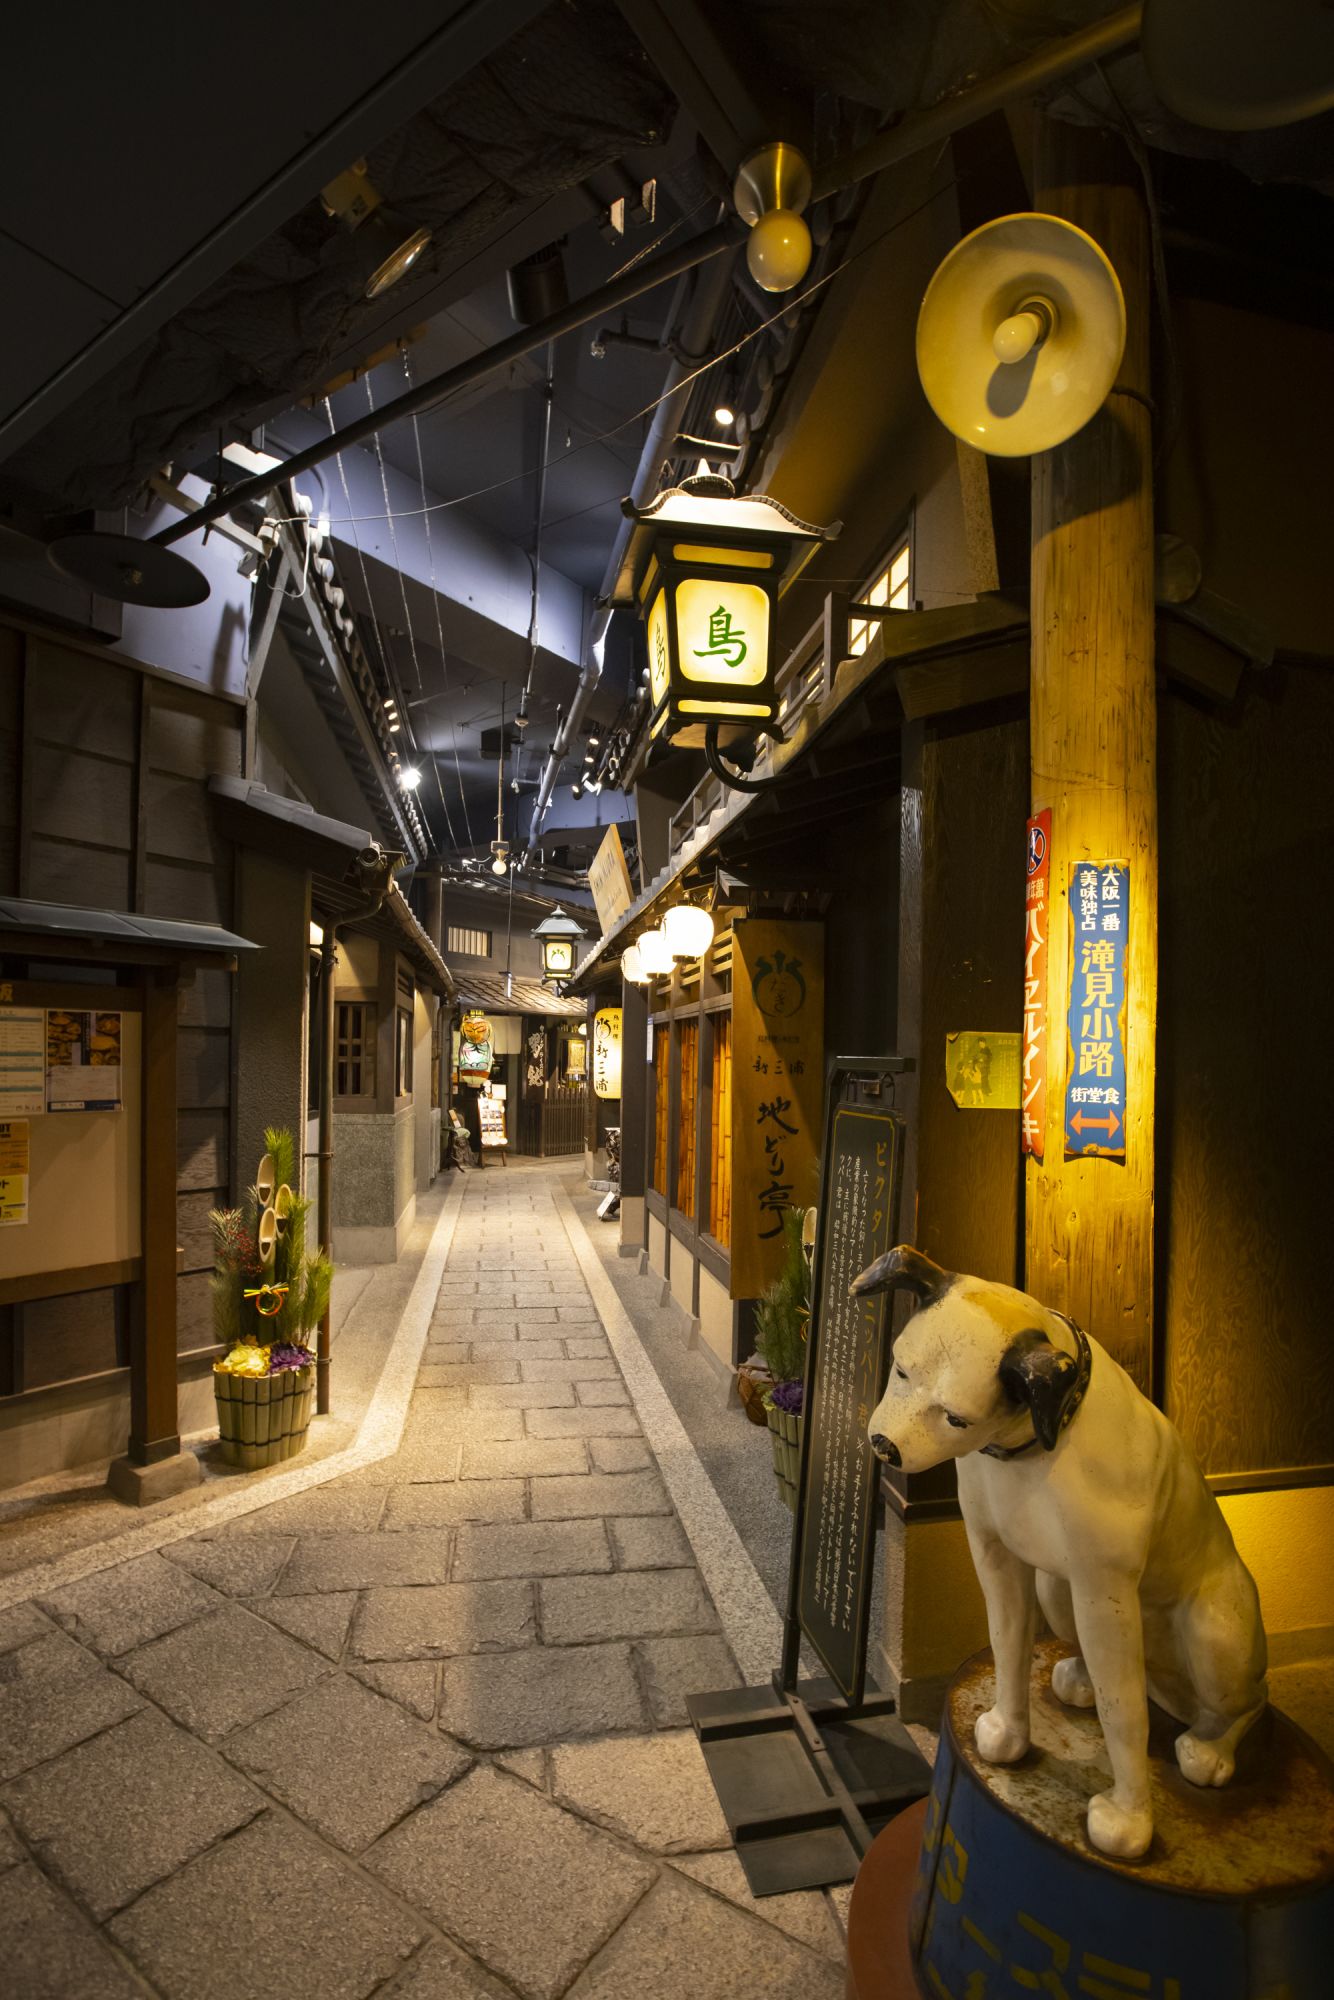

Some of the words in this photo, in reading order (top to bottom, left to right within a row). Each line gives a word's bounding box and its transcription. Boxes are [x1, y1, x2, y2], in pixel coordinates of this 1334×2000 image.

[693, 604, 747, 668] 鳥
[1079, 869, 1098, 931] 美味独占
[1102, 869, 1121, 931] 大阪一番
[1078, 939, 1116, 1078] 滝見小路
[756, 1096, 800, 1240] 地どり亭
